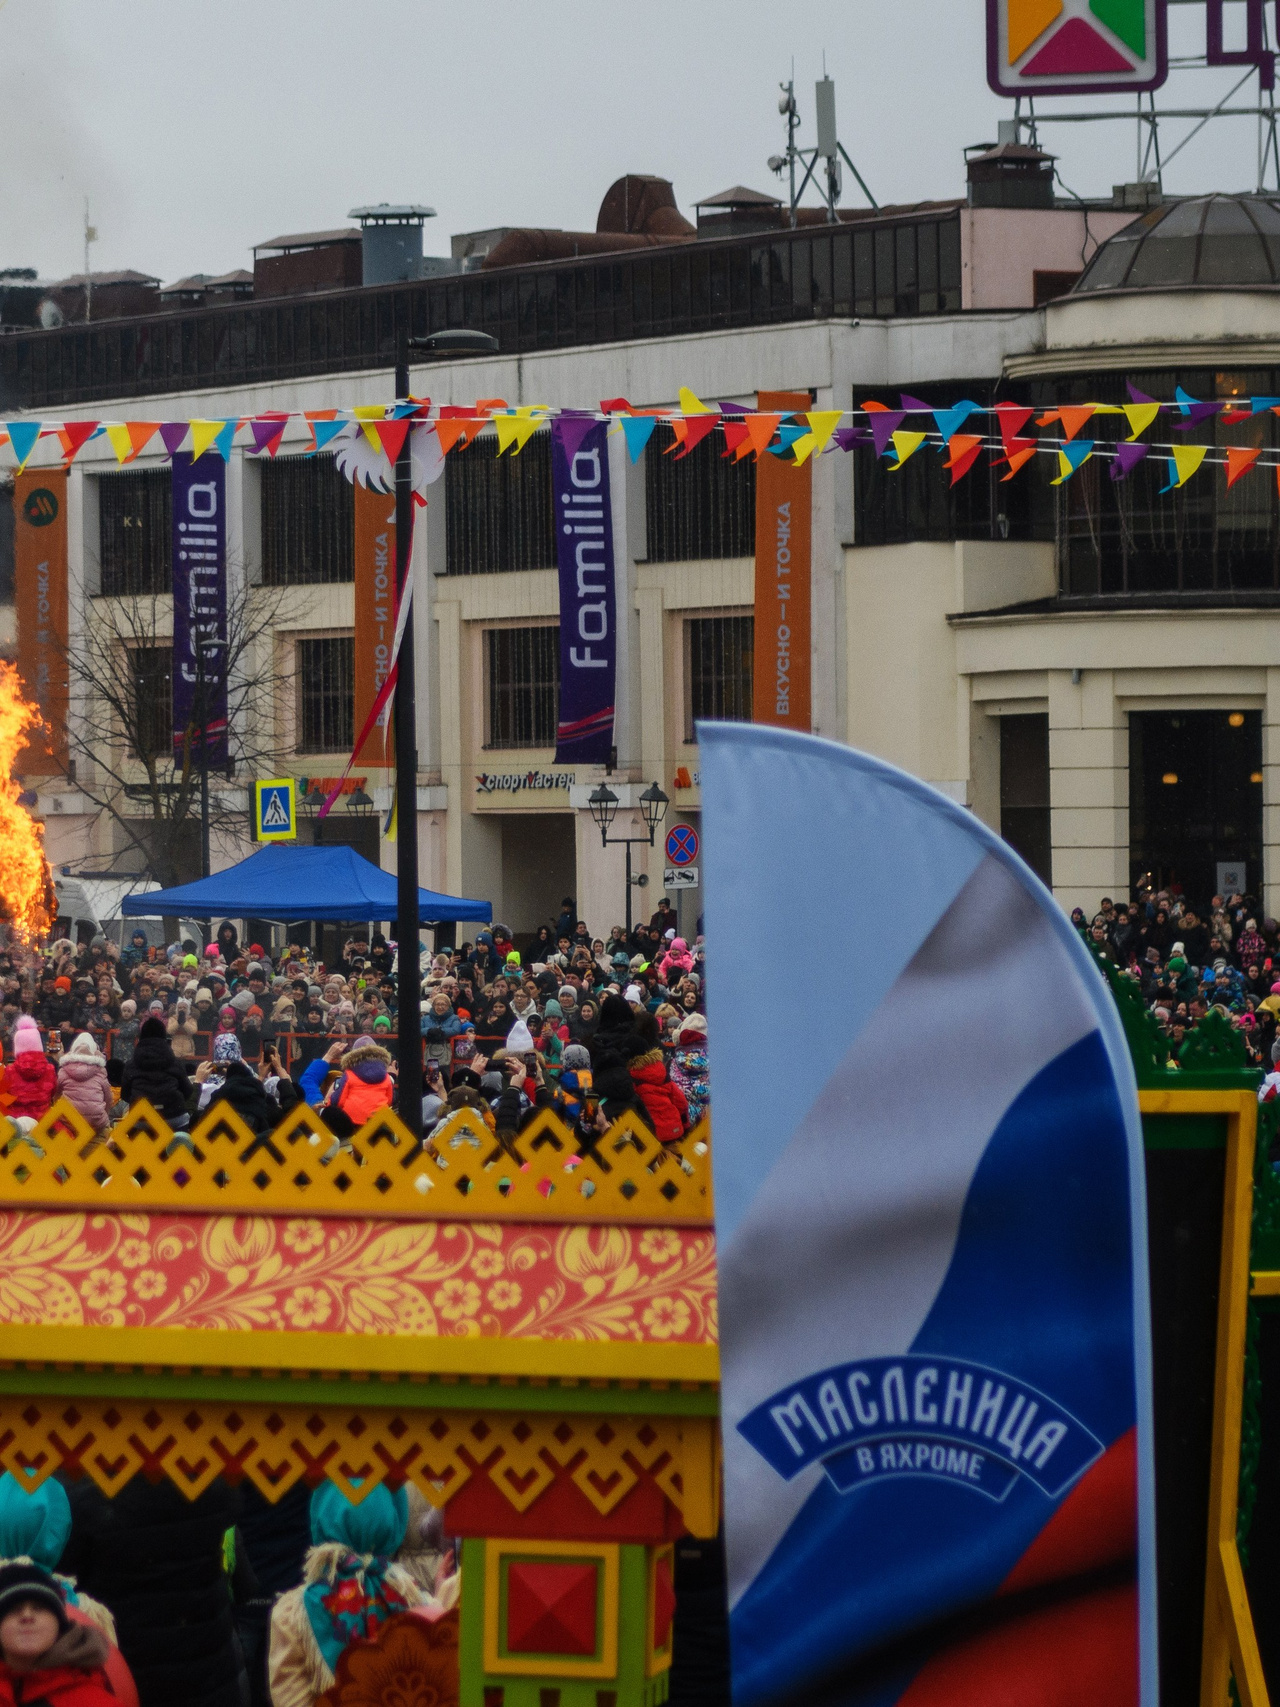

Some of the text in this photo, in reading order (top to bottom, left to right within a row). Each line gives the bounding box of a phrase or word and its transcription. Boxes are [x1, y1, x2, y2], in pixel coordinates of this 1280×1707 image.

[375, 532, 388, 601] ТОЧКА
[561, 447, 609, 668] familia
[777, 502, 791, 576] ТОЧКА
[375, 607, 388, 621] И
[777, 584, 790, 599] И
[776, 624, 791, 715] ВКУСНО
[770, 1367, 1068, 1469] МАСЛЕНИЦА
[856, 1443, 985, 1480] В ЯХРОМЕ
